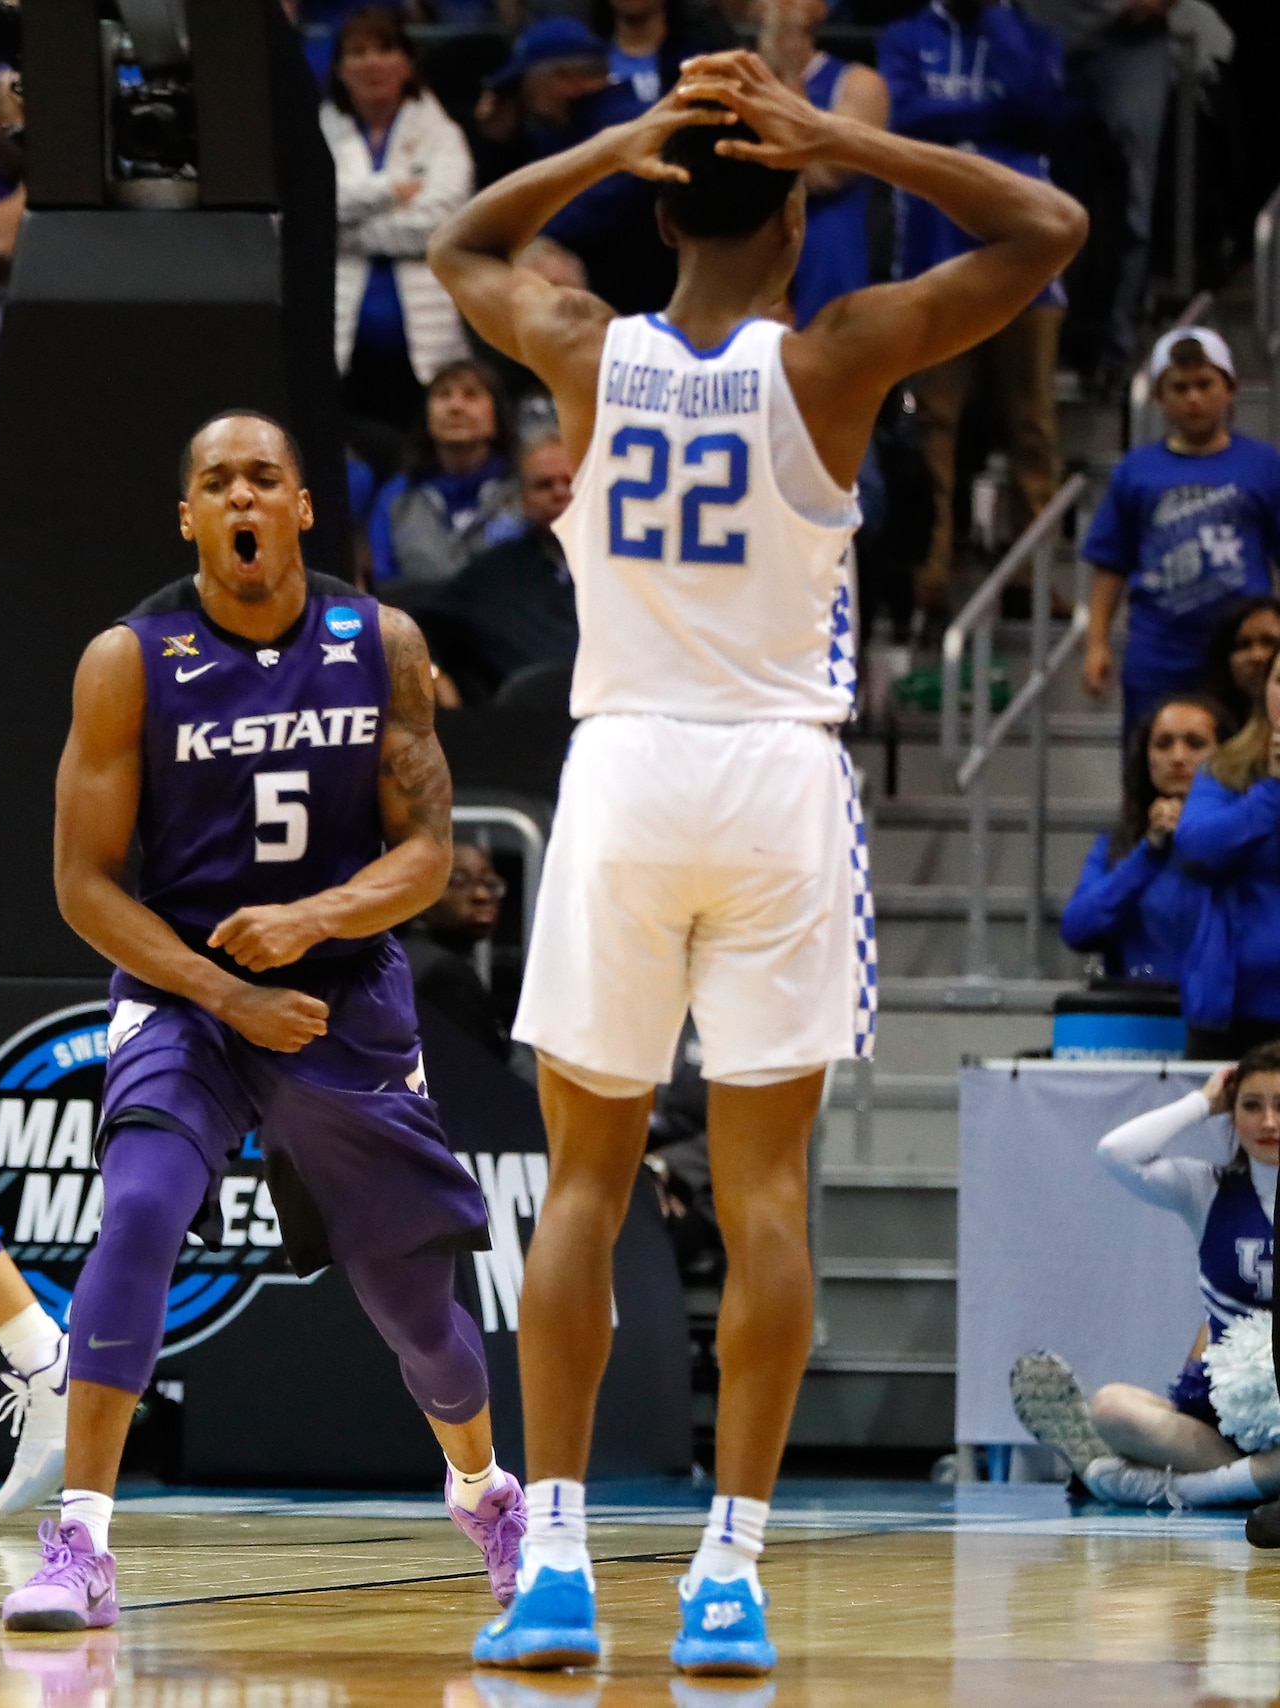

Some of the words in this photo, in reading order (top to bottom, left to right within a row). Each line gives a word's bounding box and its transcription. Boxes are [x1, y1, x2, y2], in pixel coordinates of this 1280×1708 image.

[608, 426, 748, 565] 22
[331, 620, 362, 631] NCAA
[175, 706, 380, 762] K-STATE
[253, 770, 310, 863] 5
[53, 1030, 108, 1068] SWE
